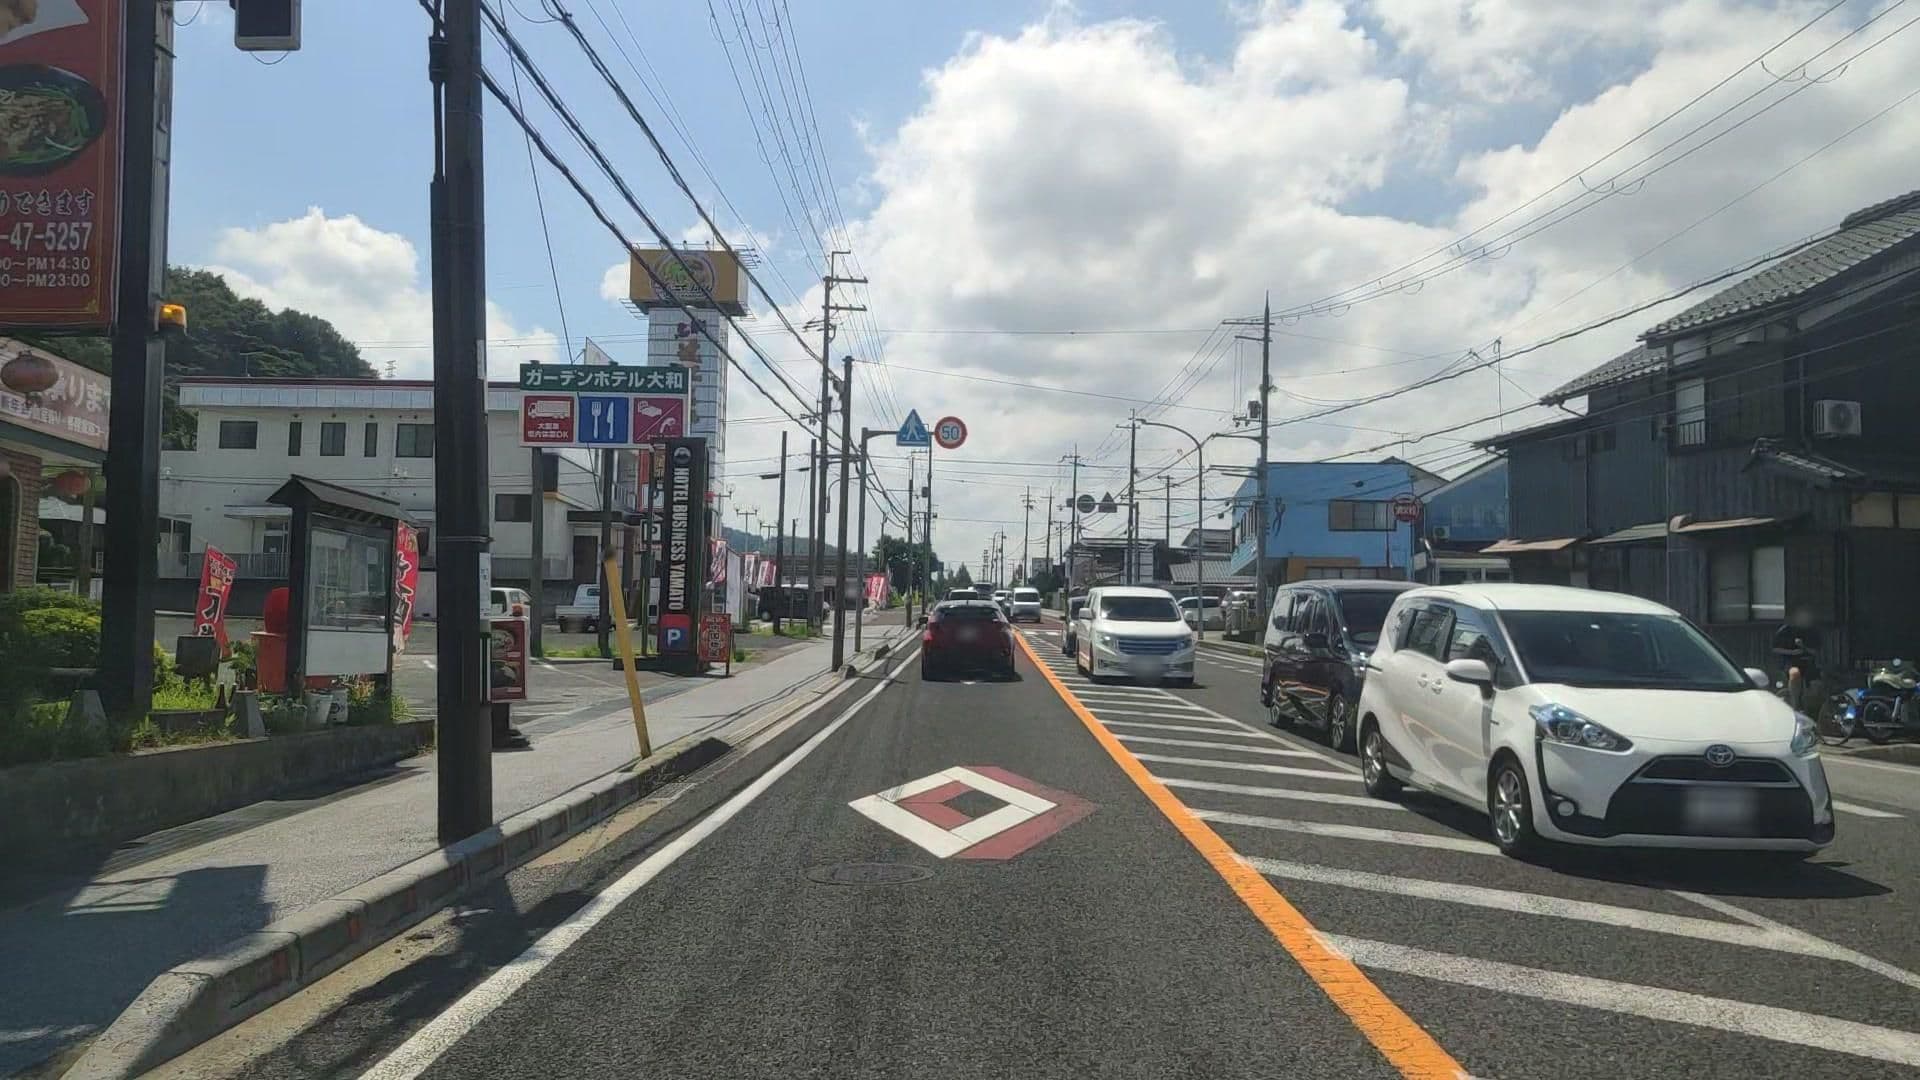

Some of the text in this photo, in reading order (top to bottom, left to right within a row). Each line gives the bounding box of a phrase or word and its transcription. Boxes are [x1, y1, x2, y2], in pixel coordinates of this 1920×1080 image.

[526, 369, 683, 389] ガーデンホテル大和
[942, 425, 960, 440] 50
[668, 467, 689, 611] HOTEL BUSINESS YAMATO
[667, 628, 681, 647] P
